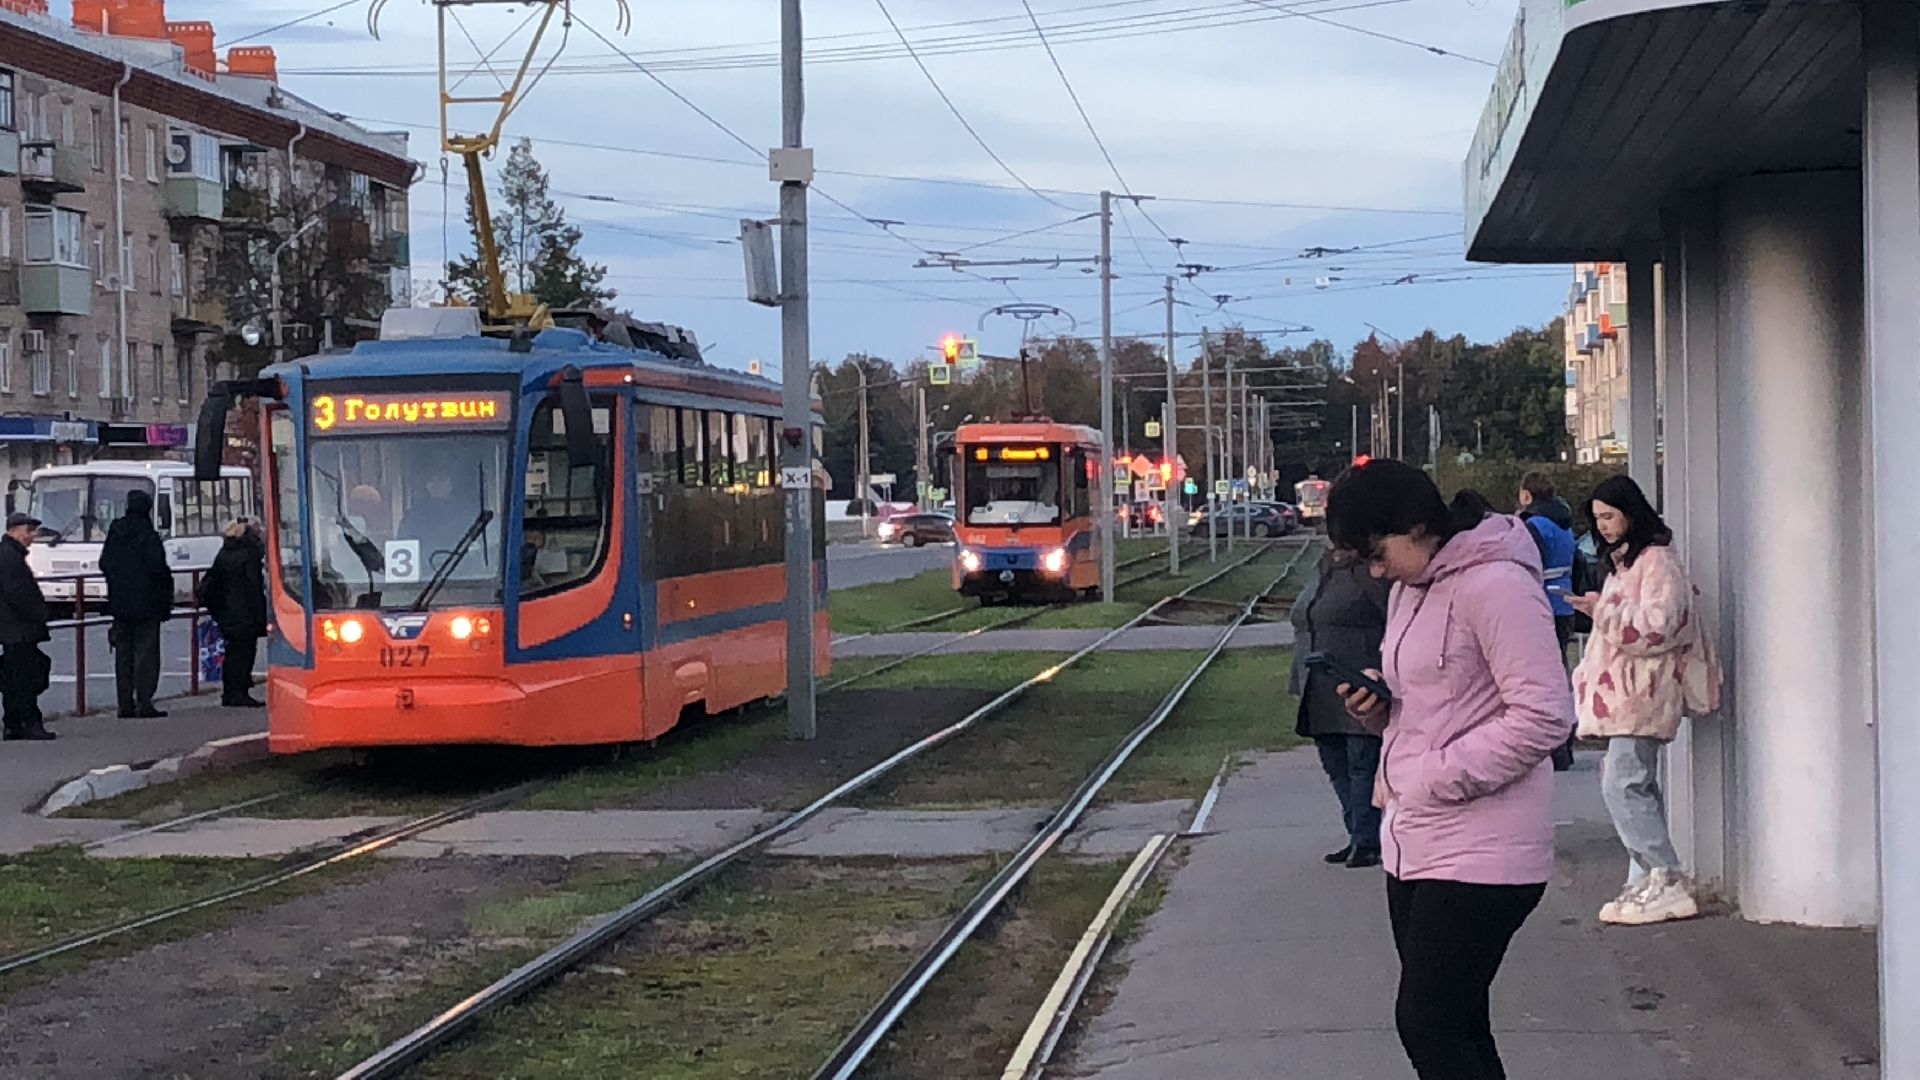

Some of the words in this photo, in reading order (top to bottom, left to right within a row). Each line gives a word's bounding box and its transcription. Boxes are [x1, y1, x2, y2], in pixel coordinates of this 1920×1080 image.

[313, 395, 336, 430] 3
[344, 398, 496, 421] Голутвин
[391, 549, 413, 577] 3
